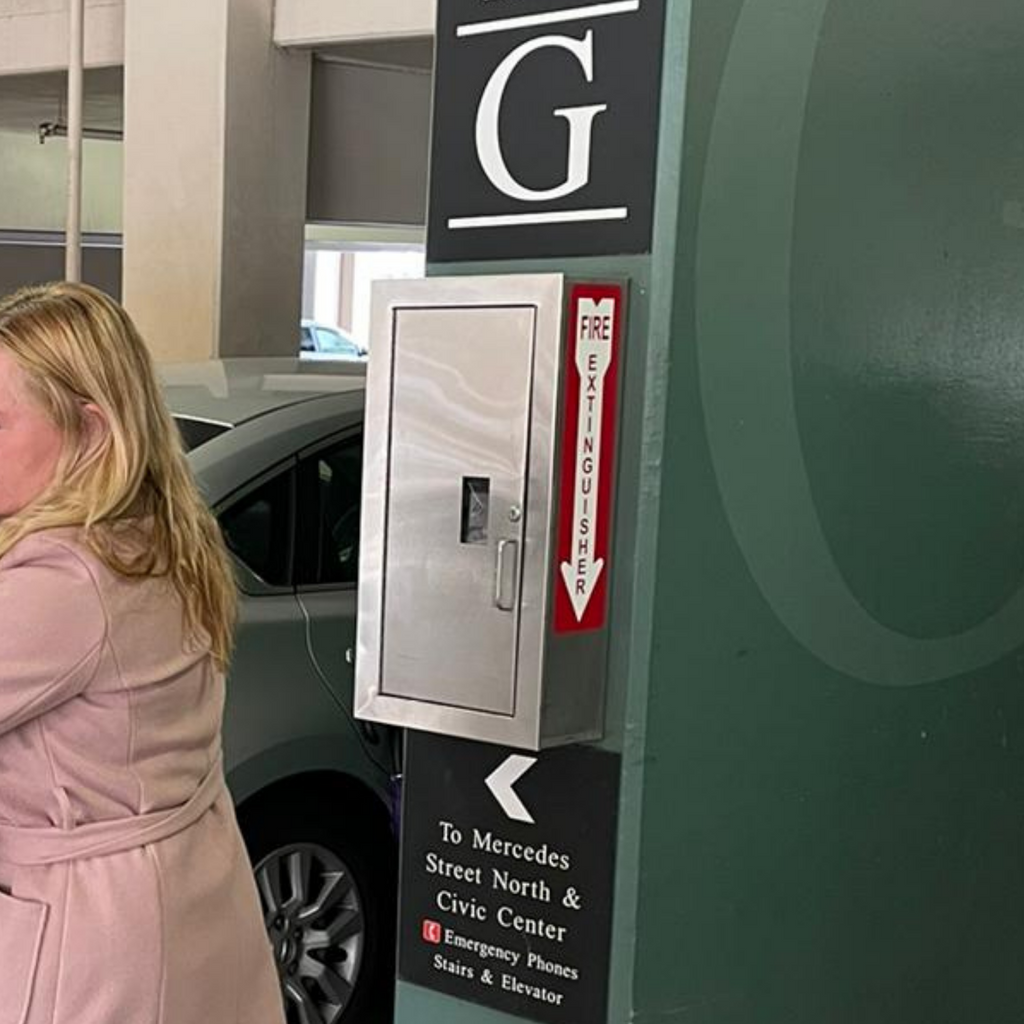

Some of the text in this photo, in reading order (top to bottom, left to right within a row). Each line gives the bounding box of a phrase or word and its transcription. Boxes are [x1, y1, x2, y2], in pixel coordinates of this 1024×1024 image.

[475, 29, 607, 201] G
[579, 315, 610, 340] FIRE
[576, 354, 597, 594] EXTINGUISHER
[439, 821, 570, 870] To Mercedes
[426, 852, 582, 910] Street North &
[436, 891, 568, 942] Civic Center
[433, 953, 564, 1005] Stairs & Elevator
[444, 928, 579, 980] Emergency Phones
